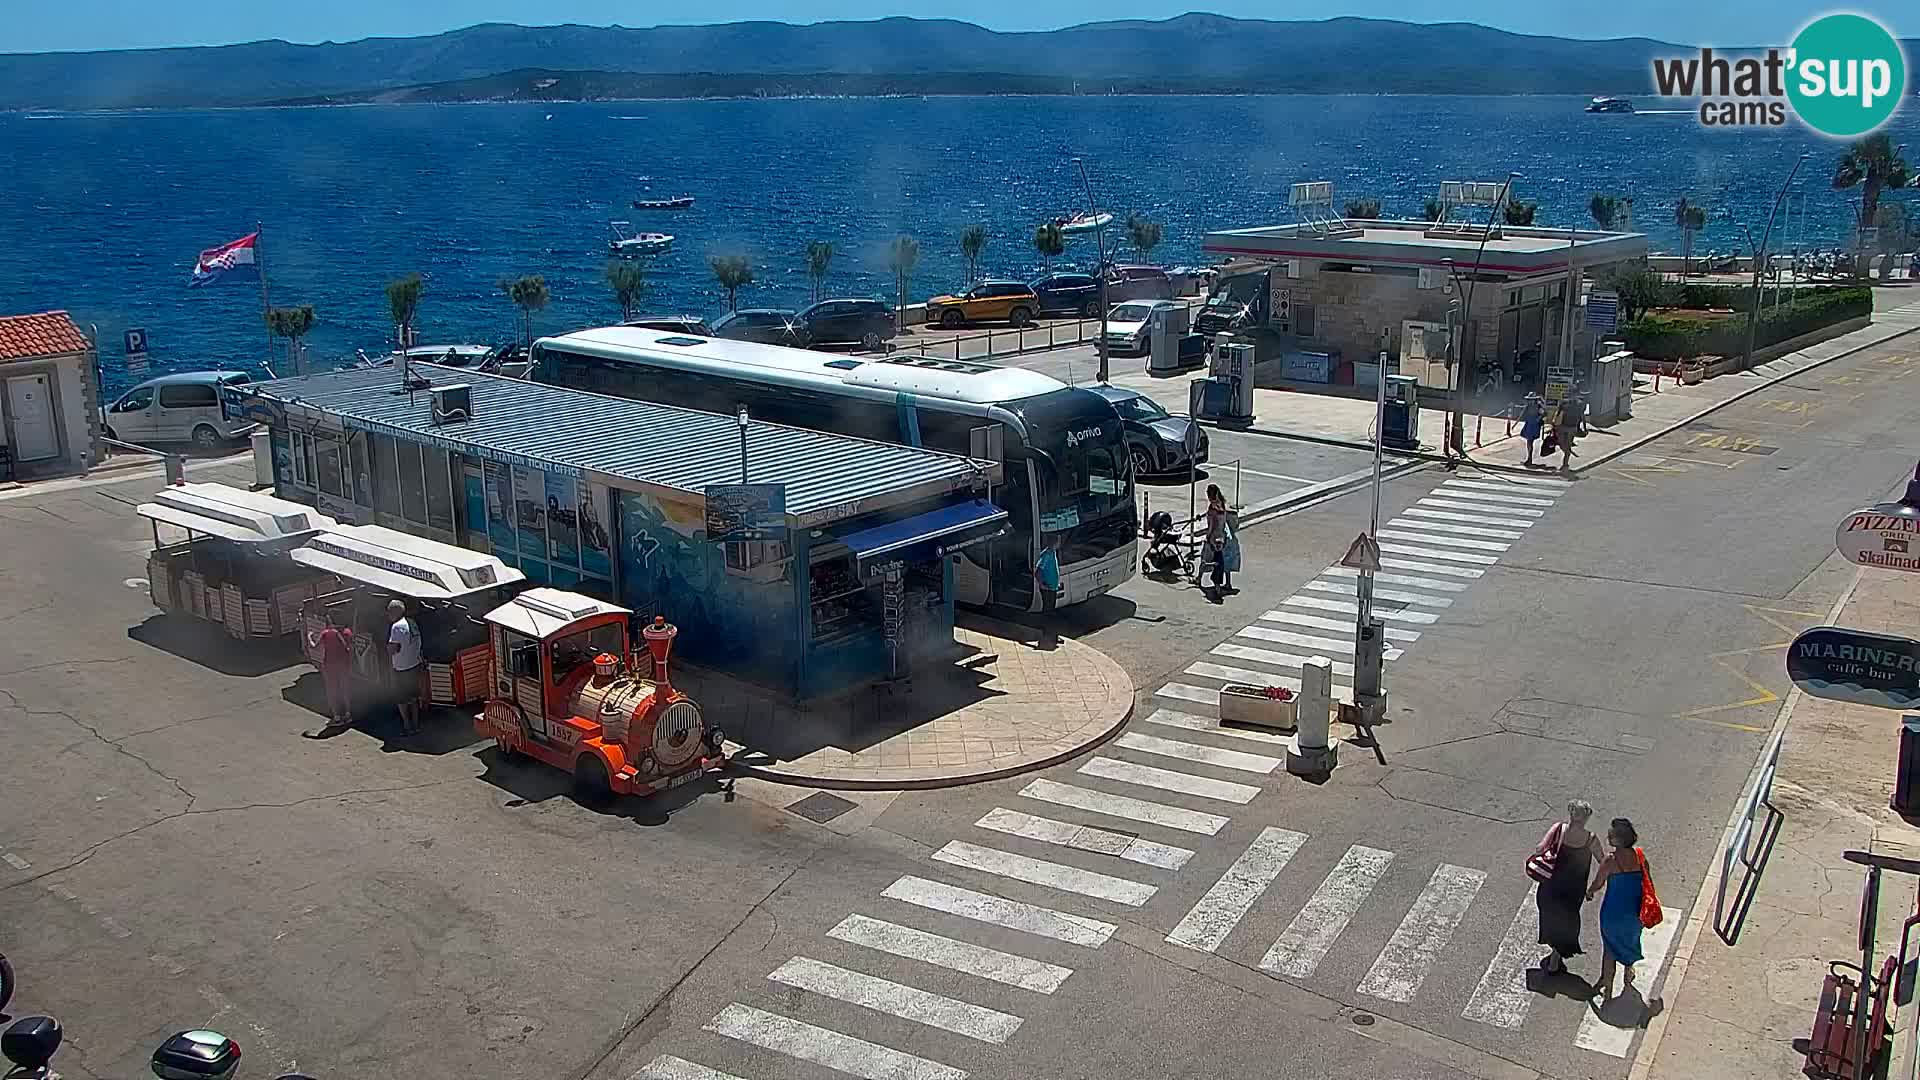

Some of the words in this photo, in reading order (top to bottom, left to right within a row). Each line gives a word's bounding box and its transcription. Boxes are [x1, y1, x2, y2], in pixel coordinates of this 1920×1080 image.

[129, 332, 142, 350] P
[1076, 426, 1102, 441] arriva
[493, 449, 526, 466] STATION
[527, 457, 553, 473] TICKET
[554, 464, 581, 478] OFFICE
[1847, 515, 1920, 535] PIZZE
[1880, 530, 1912, 541] GRILL
[1828, 662, 1864, 676] caffe
[1868, 666, 1896, 680] bar
